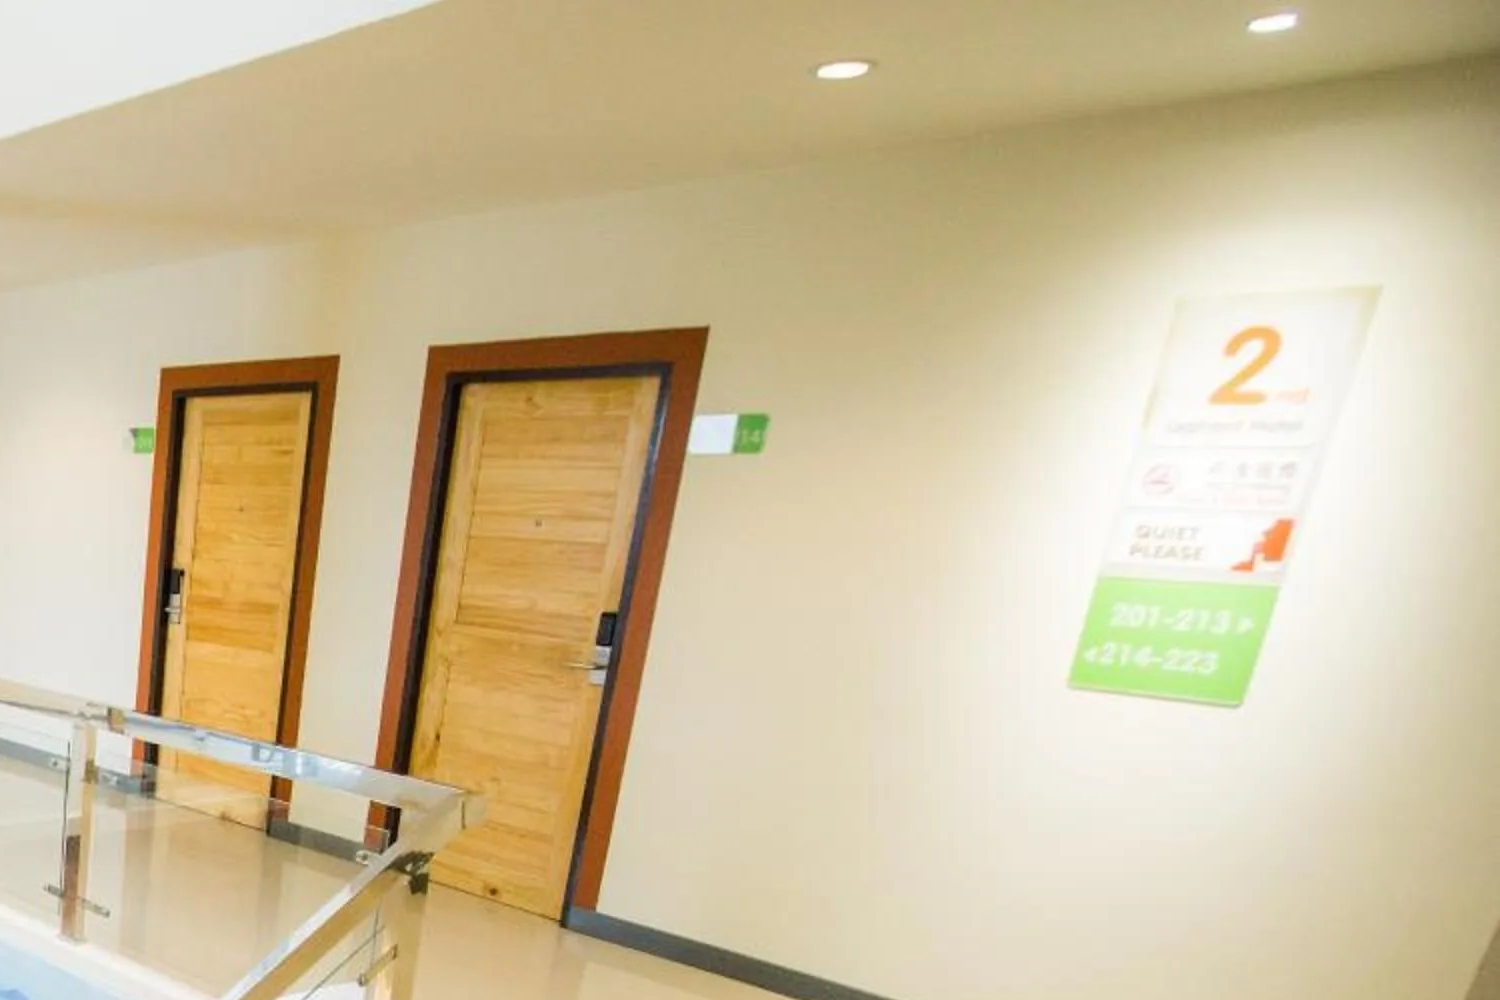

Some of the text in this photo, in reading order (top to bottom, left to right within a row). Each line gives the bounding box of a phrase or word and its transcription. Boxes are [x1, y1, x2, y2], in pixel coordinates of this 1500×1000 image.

[1208, 325, 1283, 405] 2
[1135, 524, 1202, 541] QUIET
[1128, 543, 1204, 561] PLEASE
